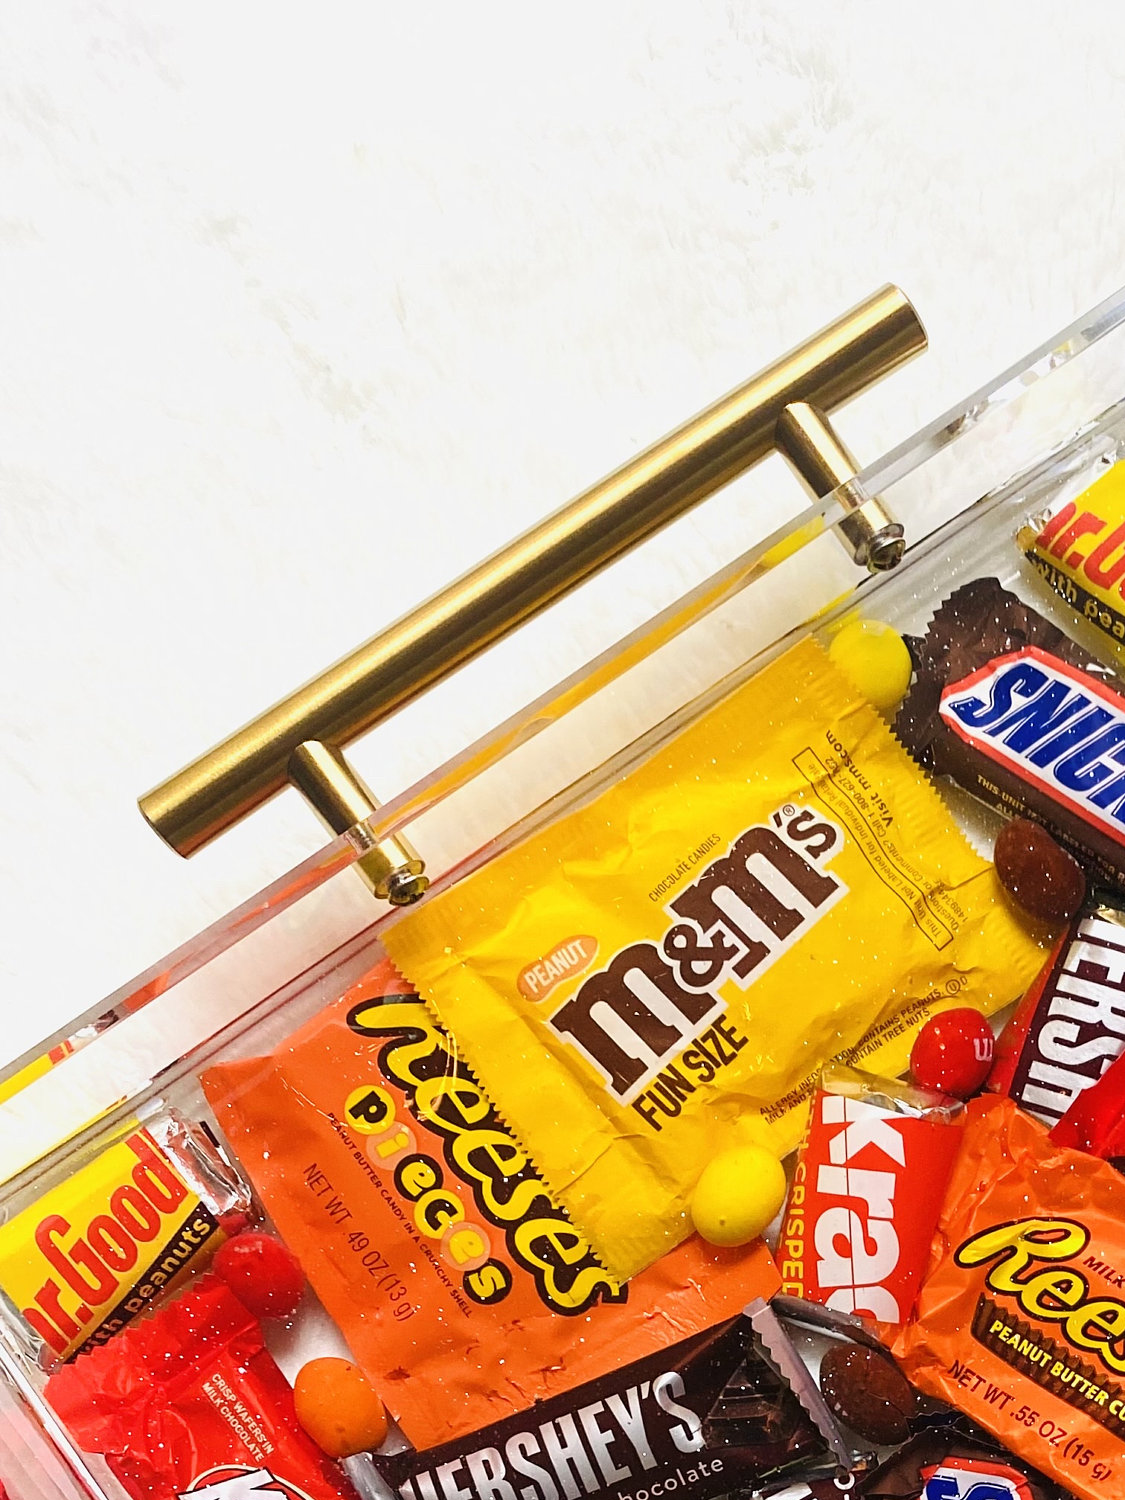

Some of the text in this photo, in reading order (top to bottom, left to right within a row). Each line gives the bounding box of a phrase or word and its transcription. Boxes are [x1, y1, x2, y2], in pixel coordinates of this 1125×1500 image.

[871, 793, 894, 827] Visit
[977, 775, 1000, 796] THIS
[648, 833, 722, 902] CHOCOLATE CANDIES
[523, 938, 588, 994] PEANUT
[632, 1014, 748, 1131] FUN SIZE
[858, 1015, 901, 1046] CONTAINS
[883, 1025, 906, 1043] TREE
[352, 1000, 622, 1310] Reeses
[302, 1162, 410, 1303] NET WT OZ (13
[327, 1112, 472, 1318] PEANUT BUTTER CANDY CRUNCHY SHELL
[782, 1162, 806, 1299] CRISPED
[124, 1218, 210, 1314] peanuts
[990, 1319, 1052, 1368] PEANUT
[1051, 1361, 1109, 1407] BUTTER
[202, 1382, 265, 1462] MILK CHOCOLATE
[211, 1373, 265, 1443] CRISP WAFERS
[950, 1359, 987, 1395] NET
[984, 1381, 1016, 1410] WT
[1037, 1420, 1068, 1448] OZ
[1063, 1437, 1092, 1468] (15
